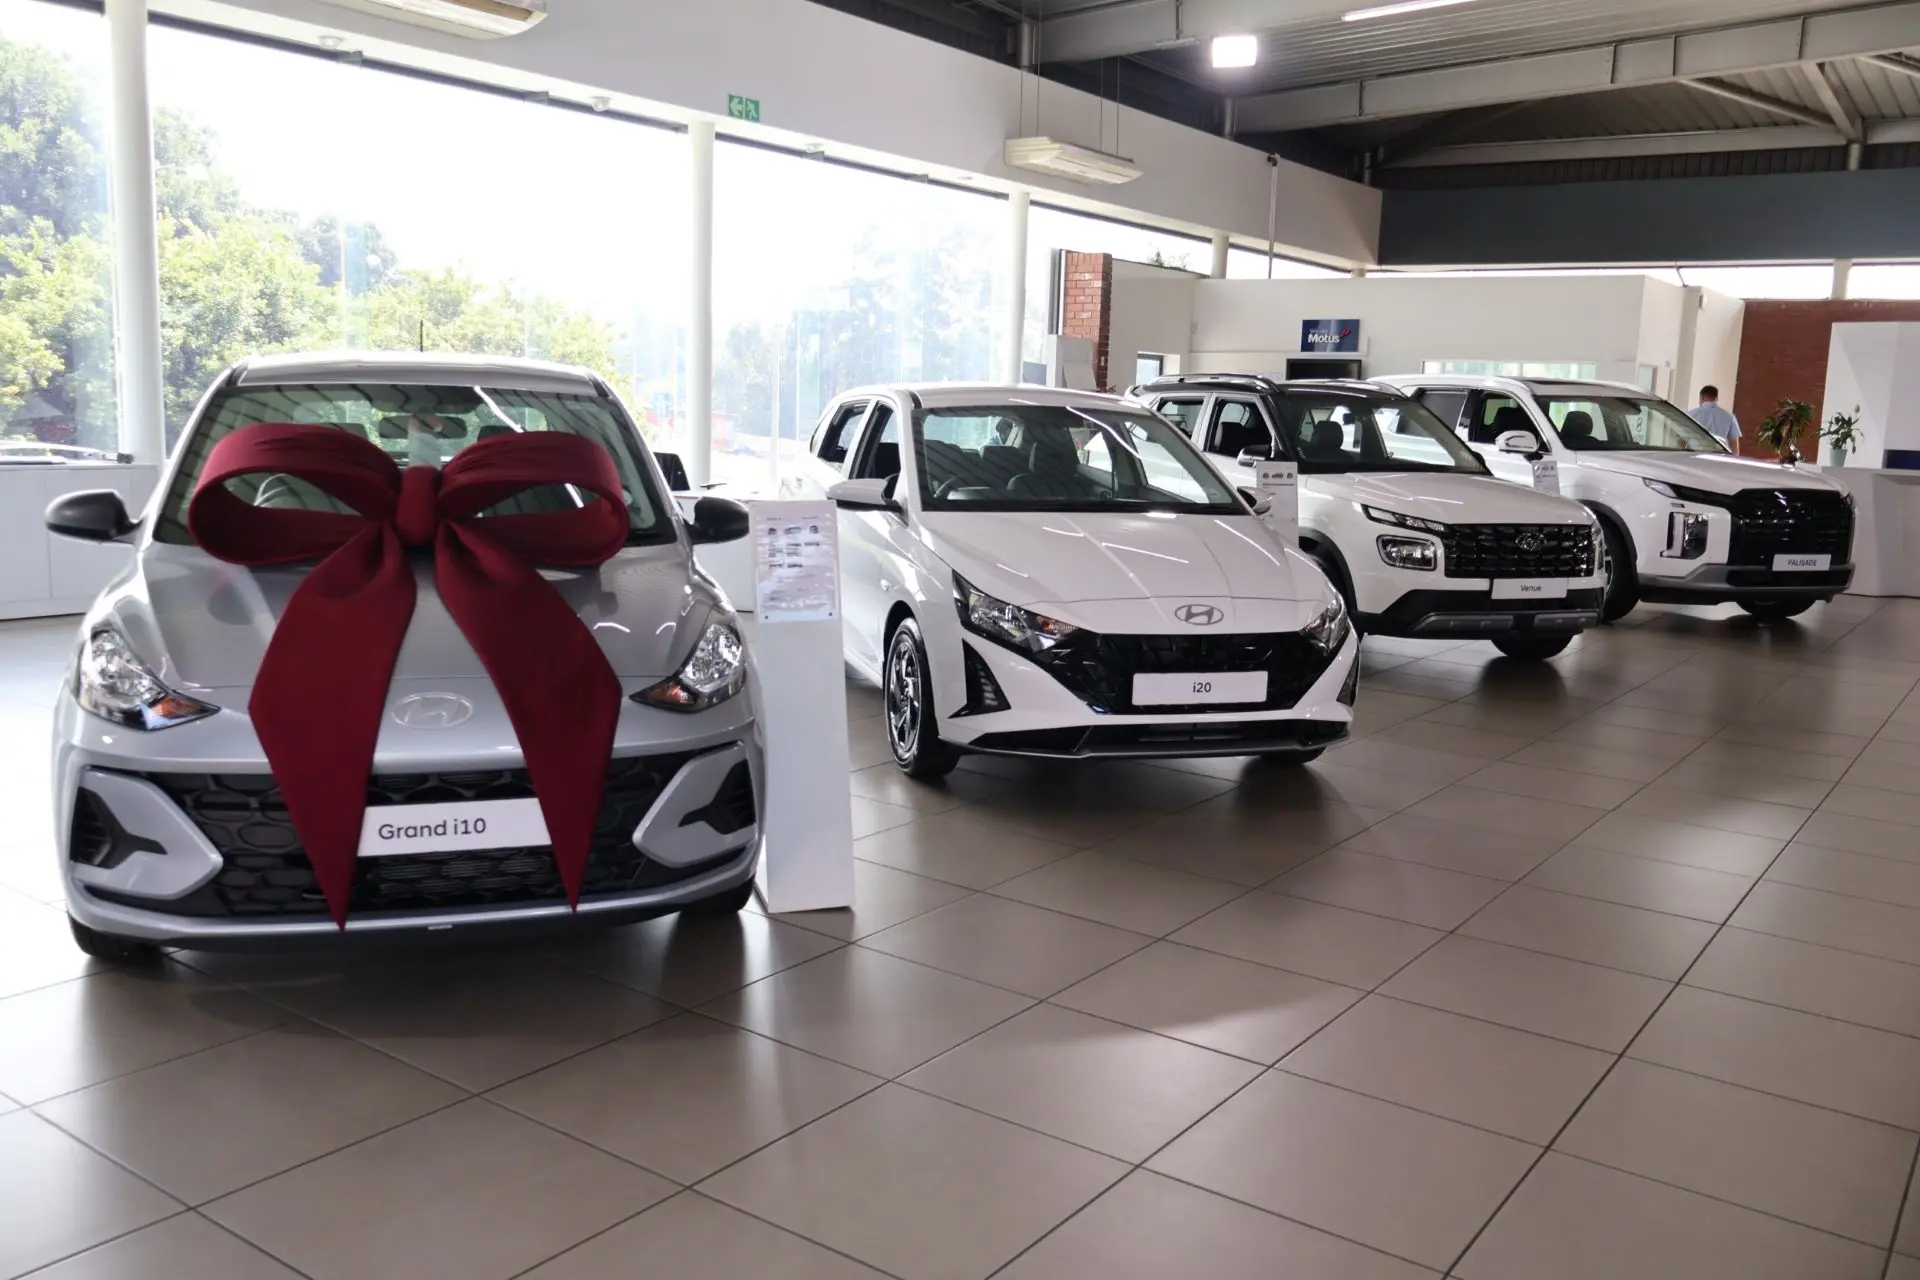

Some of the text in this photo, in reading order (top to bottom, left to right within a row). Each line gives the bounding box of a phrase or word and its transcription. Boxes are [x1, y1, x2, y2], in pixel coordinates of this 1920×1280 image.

[1307, 333, 1340, 343] Motus
[1787, 559, 1817, 567] PALISADE
[1520, 584, 1542, 592] Venue
[1192, 682, 1212, 693] i20
[378, 818, 487, 840] Grand i10
